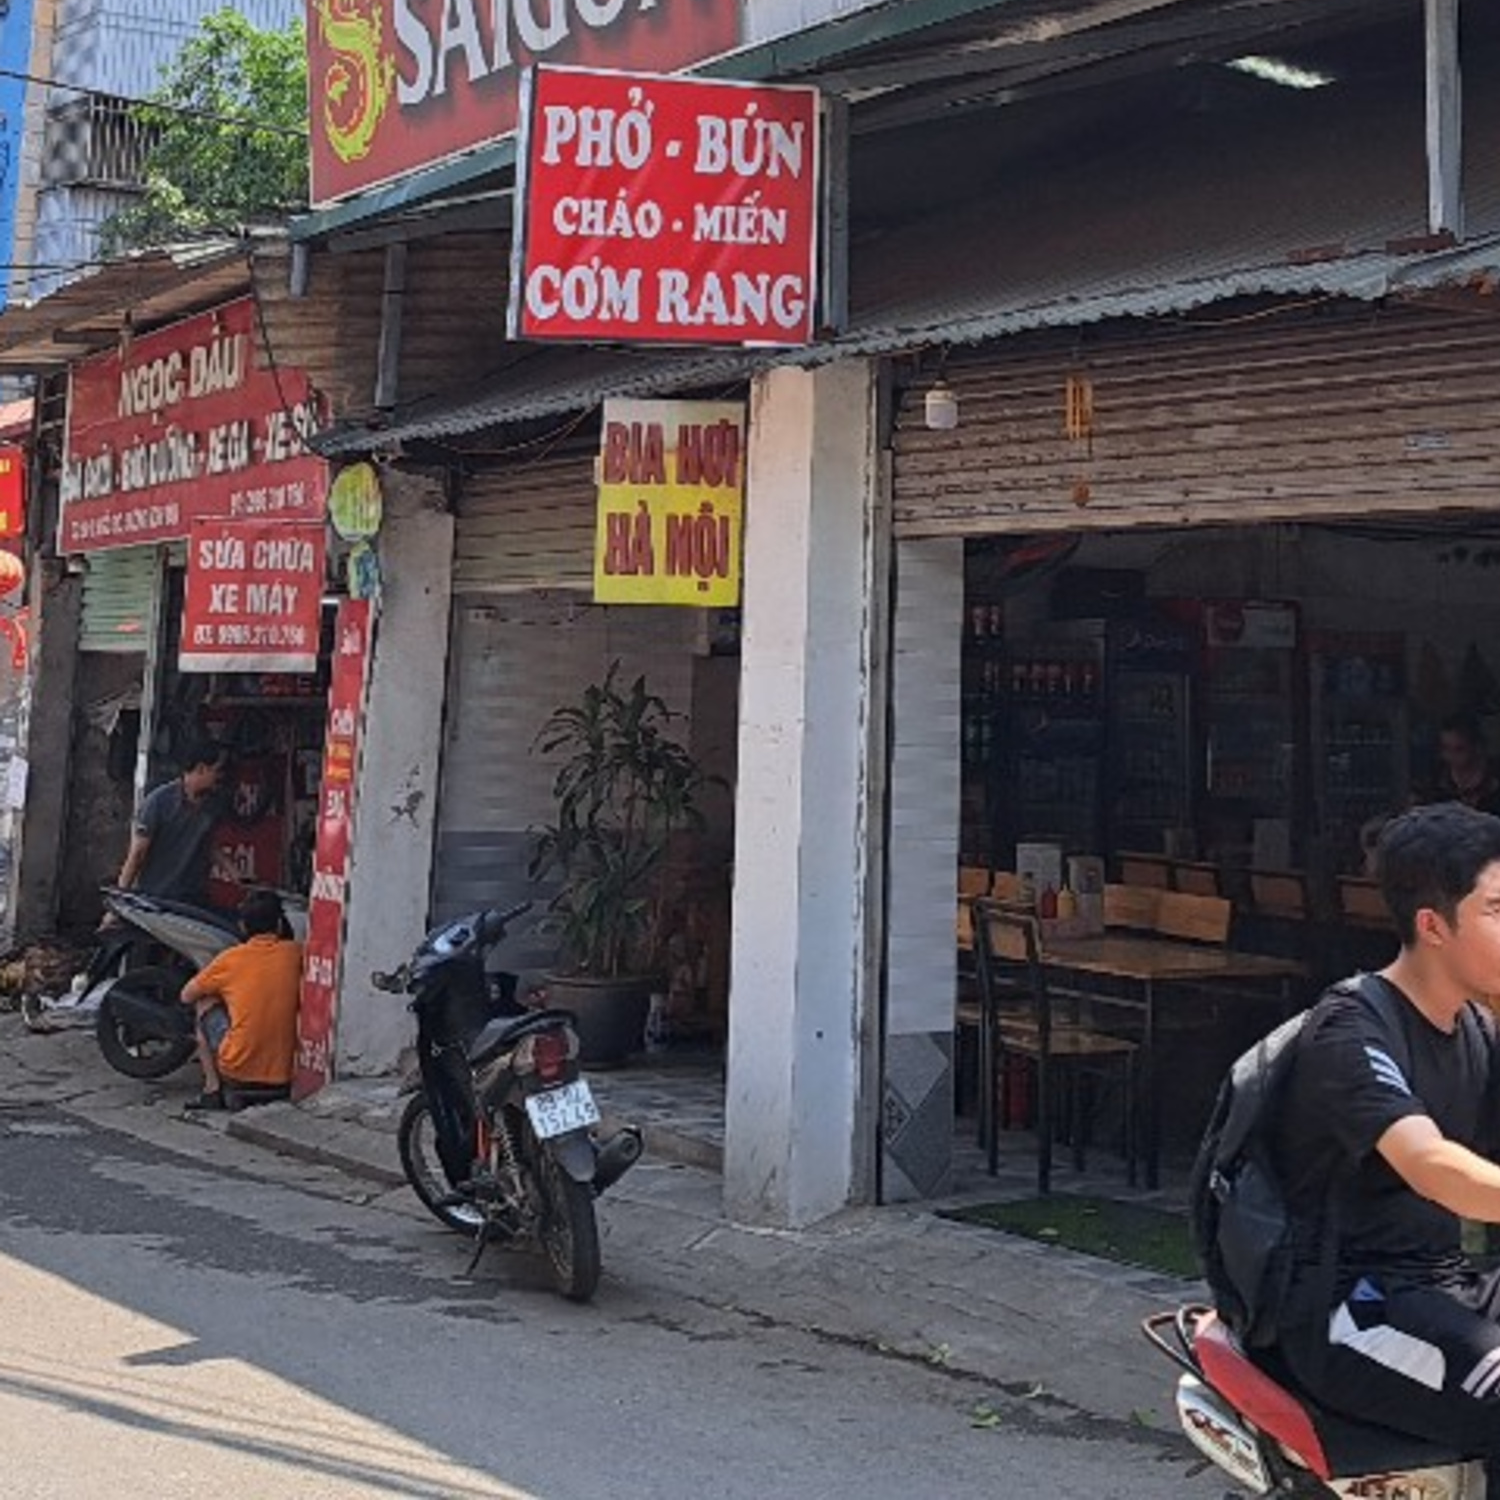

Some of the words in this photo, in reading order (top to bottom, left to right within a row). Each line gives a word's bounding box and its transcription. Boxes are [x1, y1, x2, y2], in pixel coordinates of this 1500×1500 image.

[541, 86, 655, 171] PHỞ
[694, 102, 805, 179] BÚN
[692, 190, 787, 245] MIẾN
[525, 255, 643, 323] CƠM
[656, 268, 805, 329] RANG
[604, 421, 667, 485] BIA
[675, 418, 740, 488] HƠI
[604, 499, 655, 576] HÀ
[665, 500, 730, 591] NỘI
[208, 583, 239, 614] XE
[246, 578, 298, 615] MÁY
